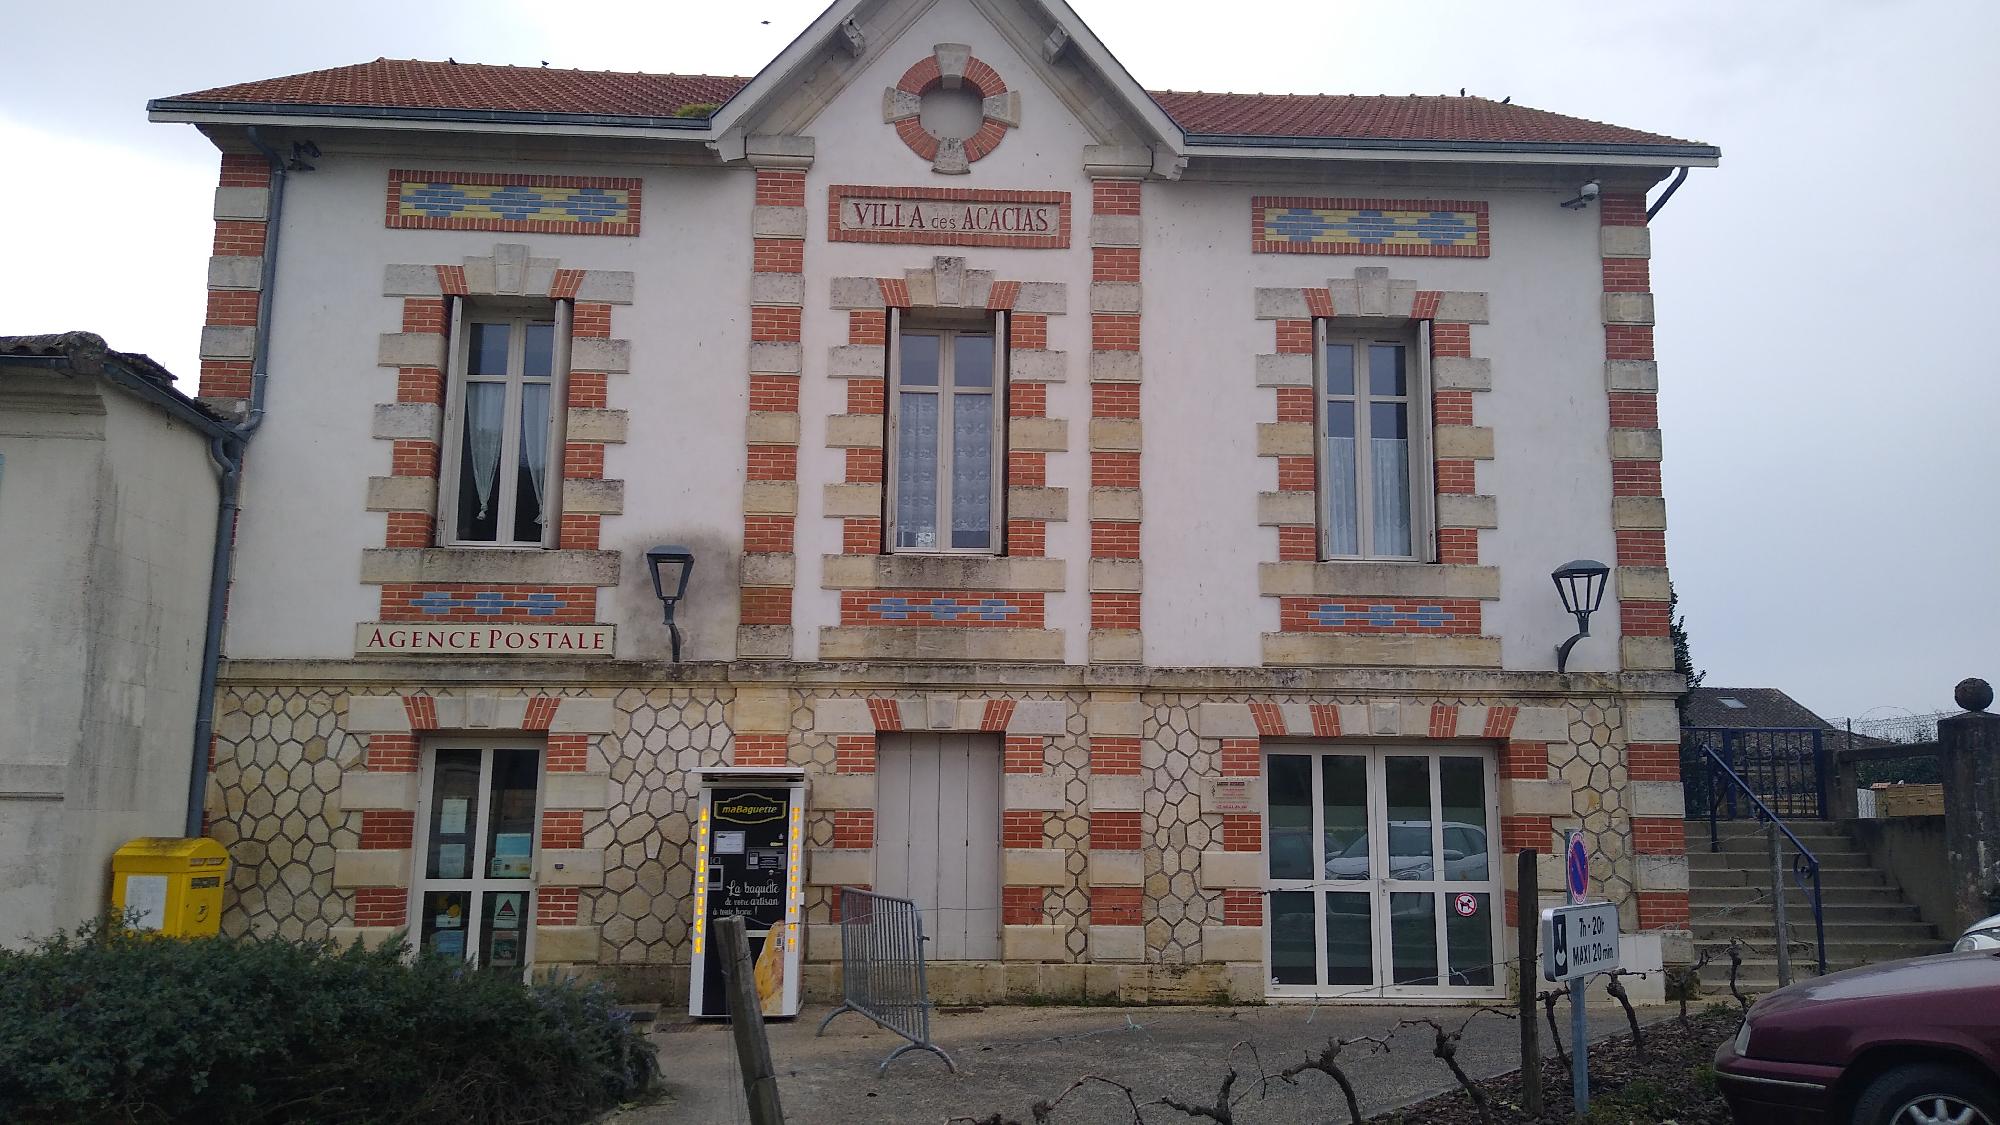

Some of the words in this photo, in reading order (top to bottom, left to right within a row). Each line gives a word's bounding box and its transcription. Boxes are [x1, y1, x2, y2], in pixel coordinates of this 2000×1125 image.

[853, 202, 925, 229] VILLA
[931, 213, 956, 230] des
[961, 206, 1048, 232] ACACIAS
[366, 627, 481, 648] AGENCE
[487, 629, 605, 650] POSTALE
[721, 805, 778, 815] maBaguette
[726, 880, 741, 897] La
[744, 879, 779, 897] baguette
[750, 897, 779, 906] artisan
[1579, 917, 1587, 938] 7h
[1572, 944, 1590, 967] MAXI
[1592, 942, 1602, 962] 20
[1602, 943, 1614, 961] min
